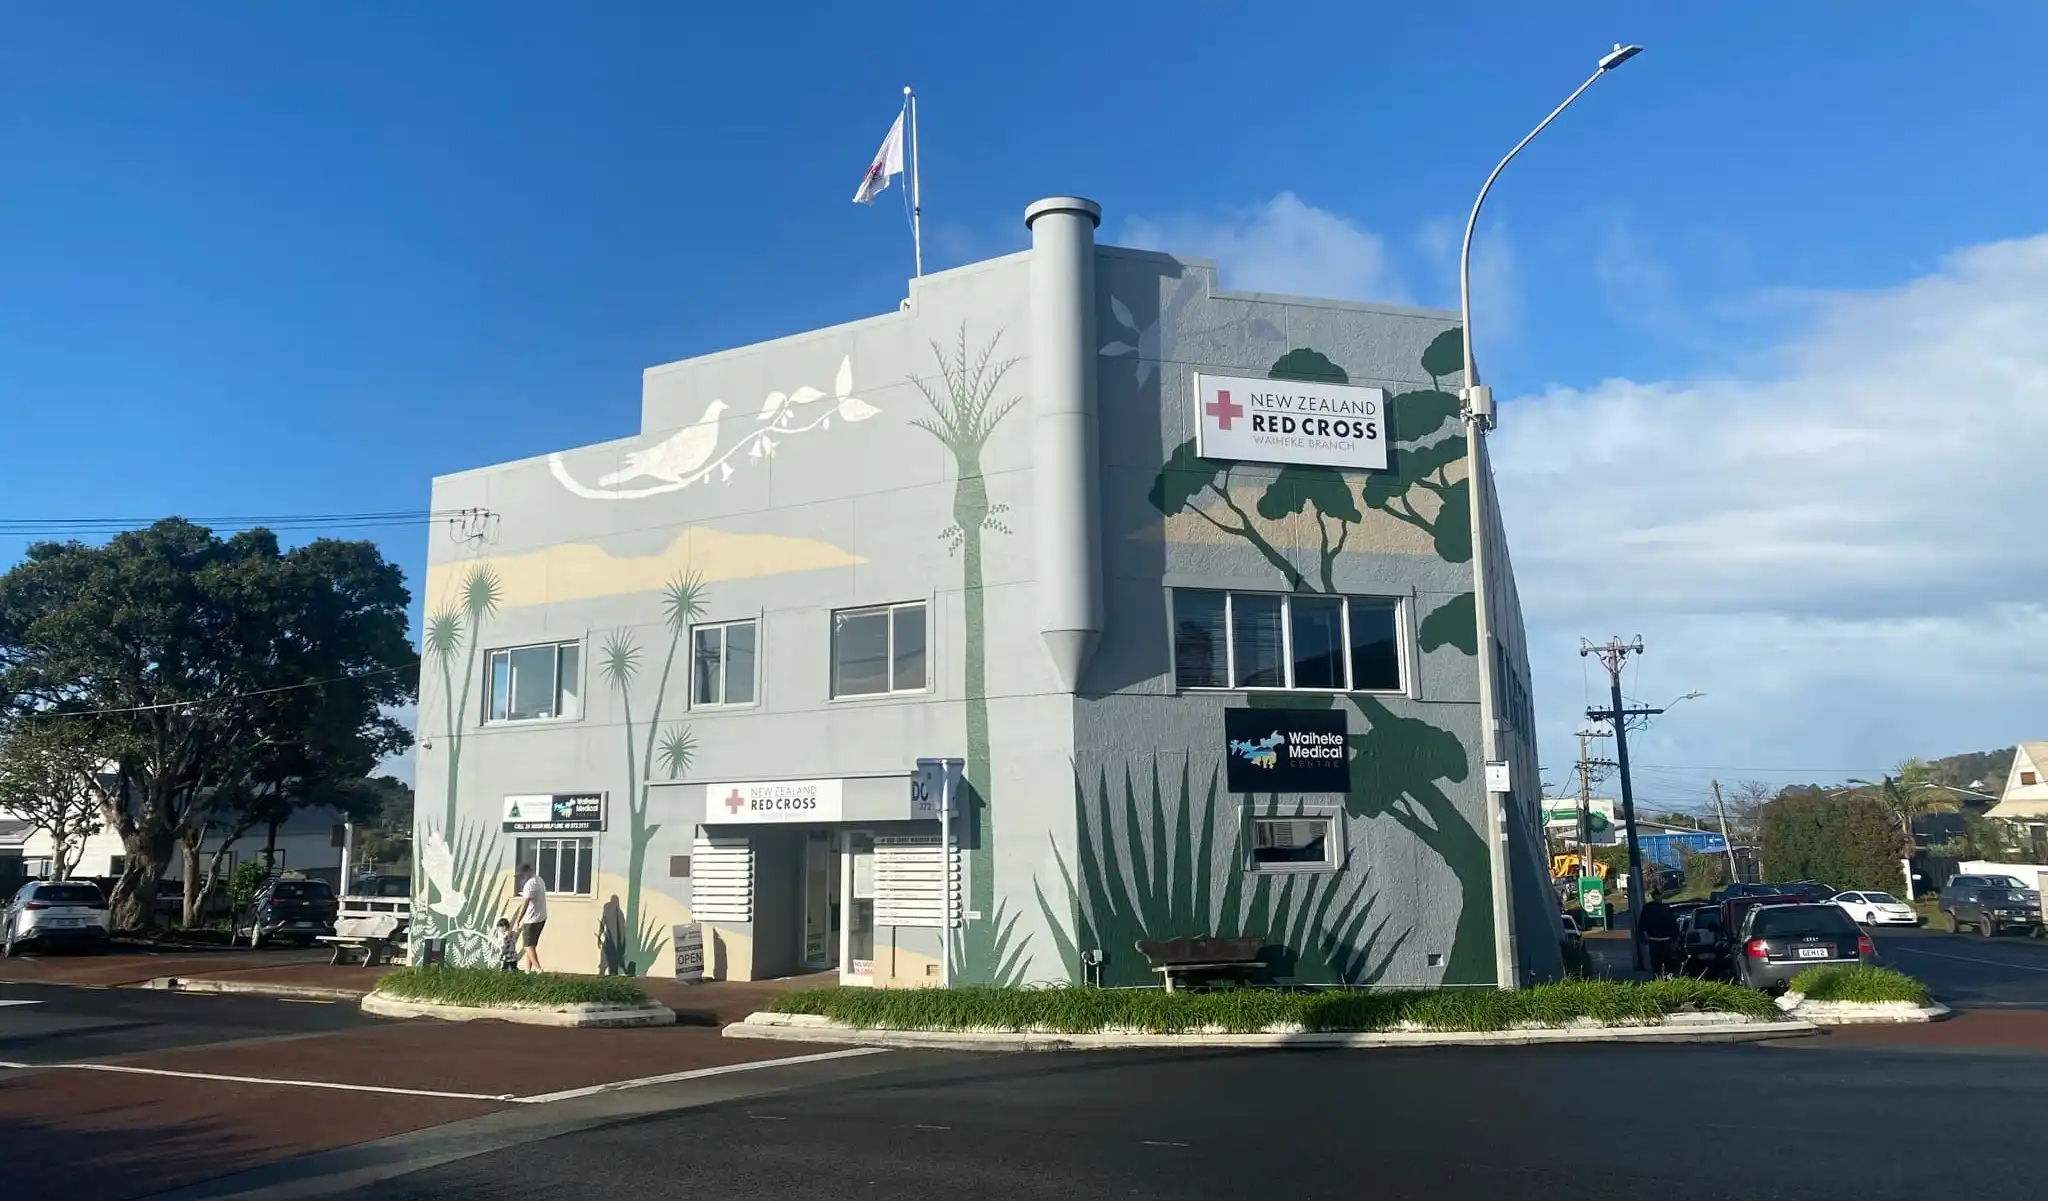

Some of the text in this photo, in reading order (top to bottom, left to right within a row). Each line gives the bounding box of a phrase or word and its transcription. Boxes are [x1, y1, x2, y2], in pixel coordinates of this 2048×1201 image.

[1251, 393, 1376, 415] NEW ZEALAND
[1252, 415, 1377, 440] RED CROSS
[1253, 435, 1355, 452] WAIHEKE BRANCH
[1288, 732, 1344, 745] Waiheke
[1289, 746, 1342, 758] Medical
[751, 785, 817, 798] NEW ZEALAND
[751, 797, 817, 811] RED CROSS
[677, 951, 702, 965] OPEN
